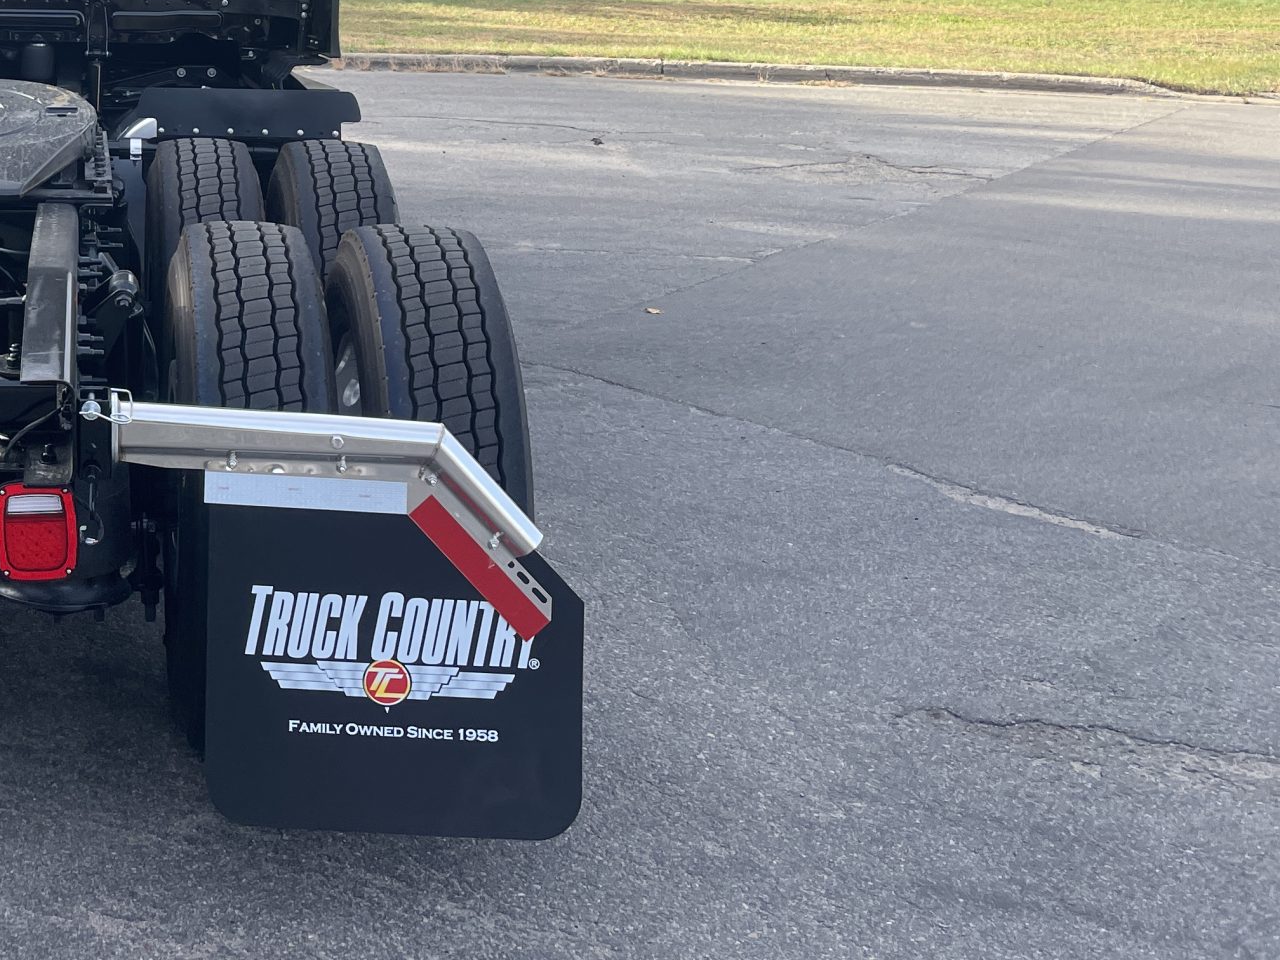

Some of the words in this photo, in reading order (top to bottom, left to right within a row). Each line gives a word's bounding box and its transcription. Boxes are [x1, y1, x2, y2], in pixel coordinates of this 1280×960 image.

[244, 585, 368, 660] TRUCK
[288, 719, 343, 735] FAMILY
[345, 722, 404, 738] OWNED
[406, 725, 454, 740] SINCE
[458, 728, 499, 742] 1958
